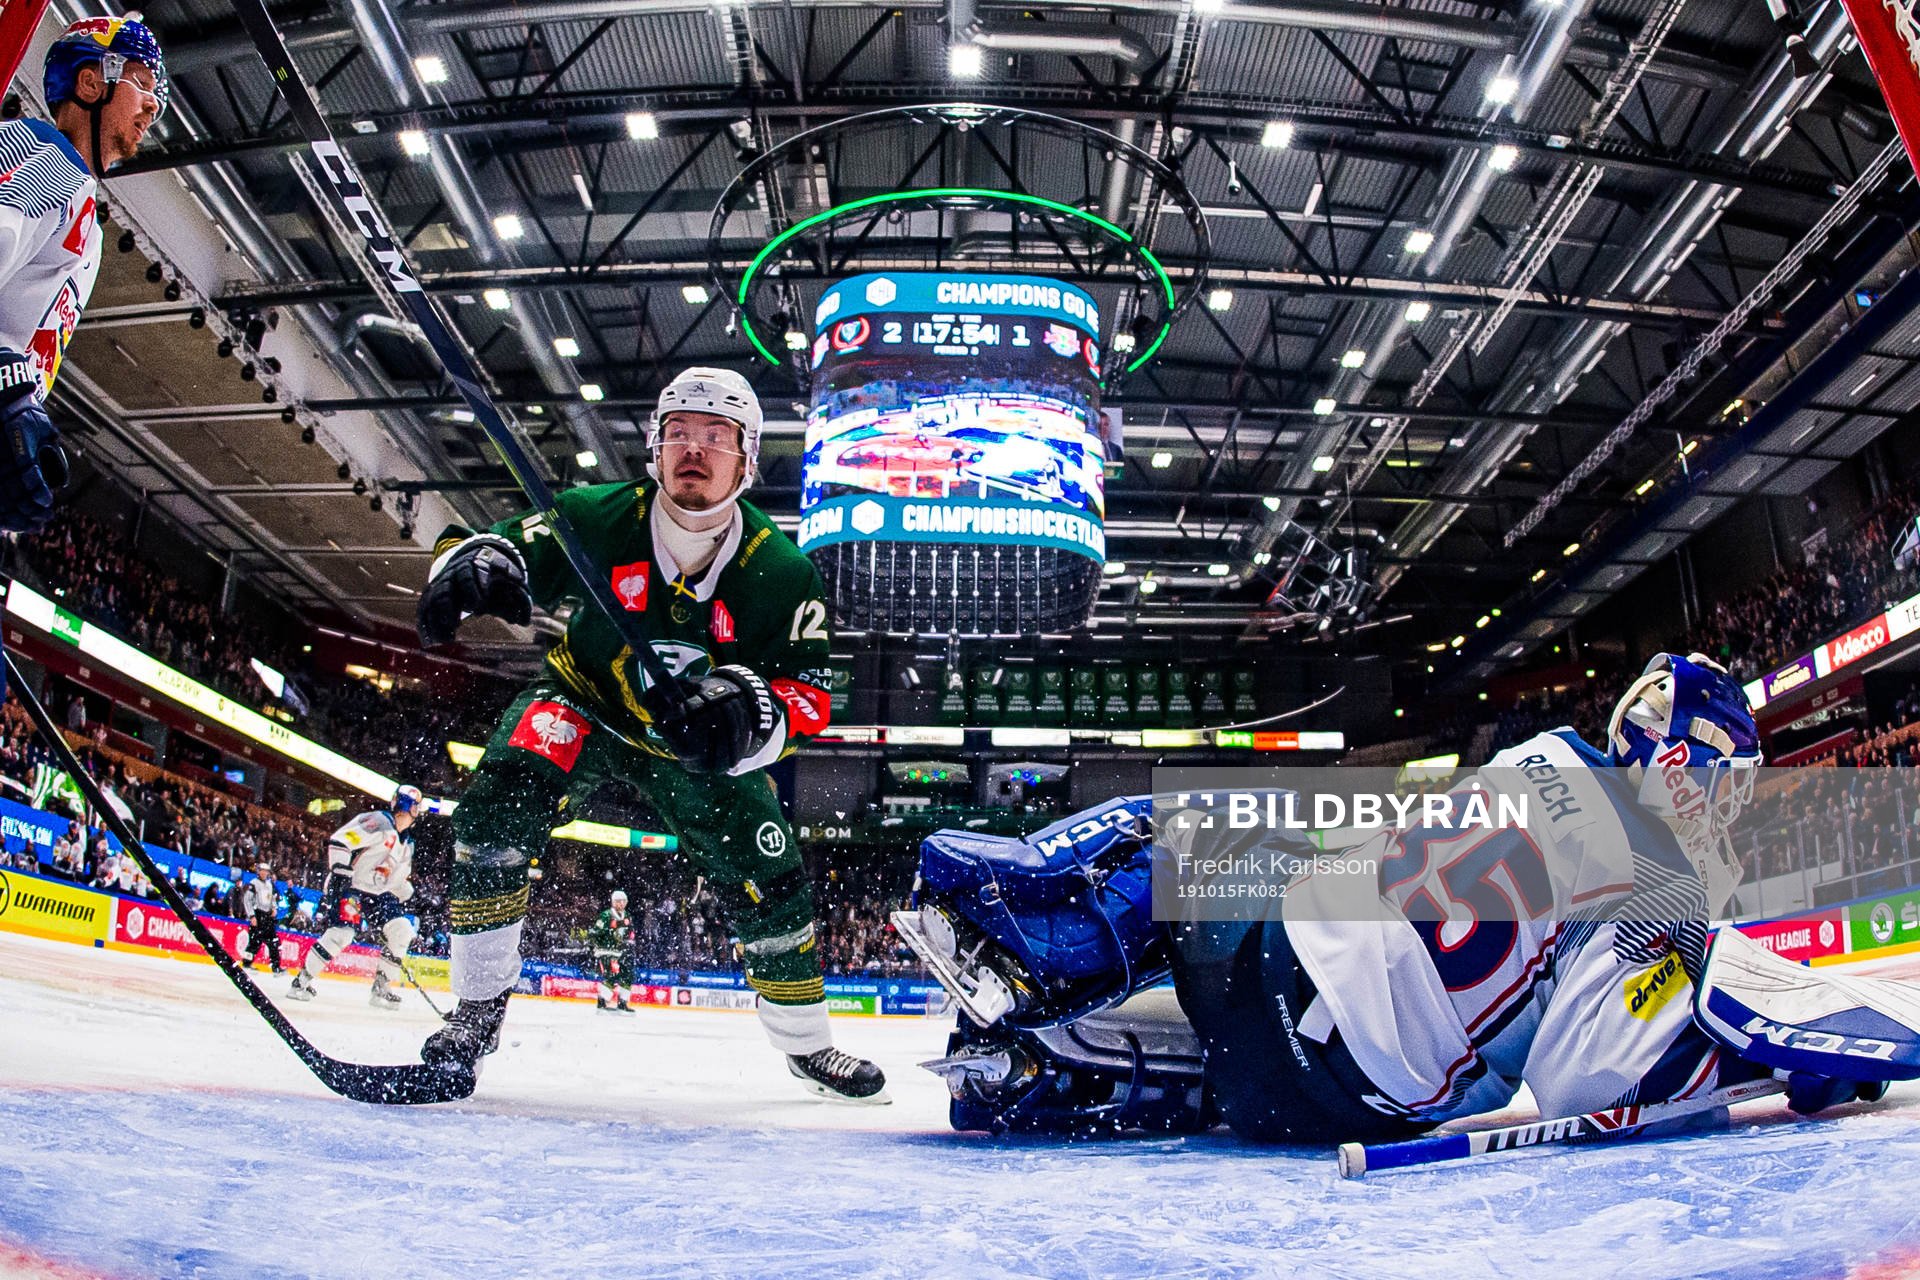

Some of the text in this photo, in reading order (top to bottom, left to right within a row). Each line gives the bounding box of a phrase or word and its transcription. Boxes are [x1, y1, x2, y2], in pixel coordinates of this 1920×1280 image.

[311, 140, 423, 292] CCM
[936, 282, 1061, 310] CHAMPIONS
[882, 322, 903, 344] 2
[918, 322, 996, 346] 17:54
[1011, 325, 1031, 347] 1
[789, 599, 829, 641] 12
[1833, 625, 1885, 668] Adecco
[1516, 754, 1582, 824] REICH
[1038, 808, 1135, 858] CCM
[13, 891, 96, 923] WARRIOR
[1775, 928, 1812, 951] LEAGUE
[735, 998, 751, 1008] APP
[1275, 994, 1309, 1068] PREMIER
[1740, 1017, 1897, 1061] CCM
